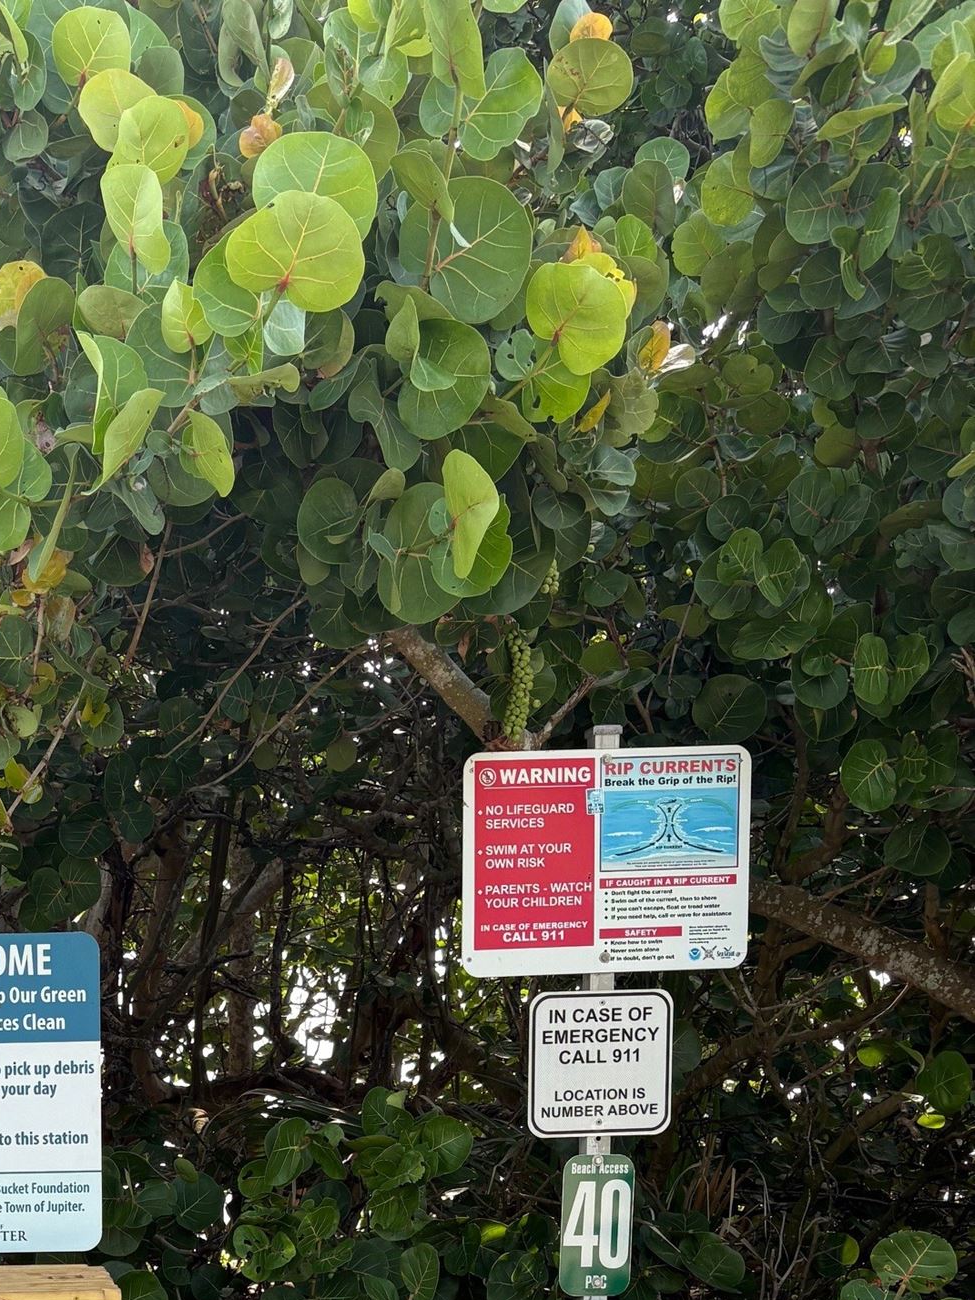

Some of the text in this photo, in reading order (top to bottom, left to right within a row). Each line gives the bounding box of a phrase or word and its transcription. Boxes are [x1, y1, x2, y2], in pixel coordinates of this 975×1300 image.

[604, 758, 736, 776] RIP CURRENTS
[500, 766, 591, 785] WARNING
[604, 775, 736, 787] Break the Grip of the Rip!
[485, 803, 575, 816] NO LIFEGUARD
[485, 817, 545, 830] SERVICES
[485, 843, 572, 856] SWIM AT YOUR
[485, 857, 545, 869] OWN RISK
[485, 883, 540, 895] PARENTS
[550, 881, 592, 893] WATCH
[616, 879, 651, 887] CAUGHT
[654, 878, 663, 886] IN
[673, 877, 687, 885] RIP
[689, 876, 730, 884] CURRENT
[485, 896, 582, 909] YOUR CHILDREN
[480, 921, 588, 932] IN CASE OF EMERGENCY
[625, 929, 658, 937] SAFETY
[503, 930, 565, 942] CALL 911
[9, 987, 37, 1004] Our
[41, 986, 87, 1003] Green
[23, 1013, 66, 1031] Clean
[549, 1007, 653, 1024] IN CASE OF
[542, 1027, 659, 1045] EMERGENCY
[559, 1048, 640, 1064] CALL 911
[4, 1061, 32, 1079] pick
[34, 1064, 51, 1079] up
[54, 1060, 95, 1075] debris
[1, 1084, 31, 1099] your
[33, 1081, 57, 1098] day
[554, 1088, 646, 1102] LOCATION IS
[541, 1103, 658, 1118] NUMBER ABOVE
[15, 1131, 40, 1146] this
[42, 1130, 89, 1145] station
[571, 1163, 629, 1175] Beach Access
[31, 1181, 90, 1195] Foundation
[4, 1201, 32, 1213] Town
[34, 1200, 45, 1213] of
[46, 1200, 85, 1215] Jupiter.
[562, 1179, 632, 1269] 40
